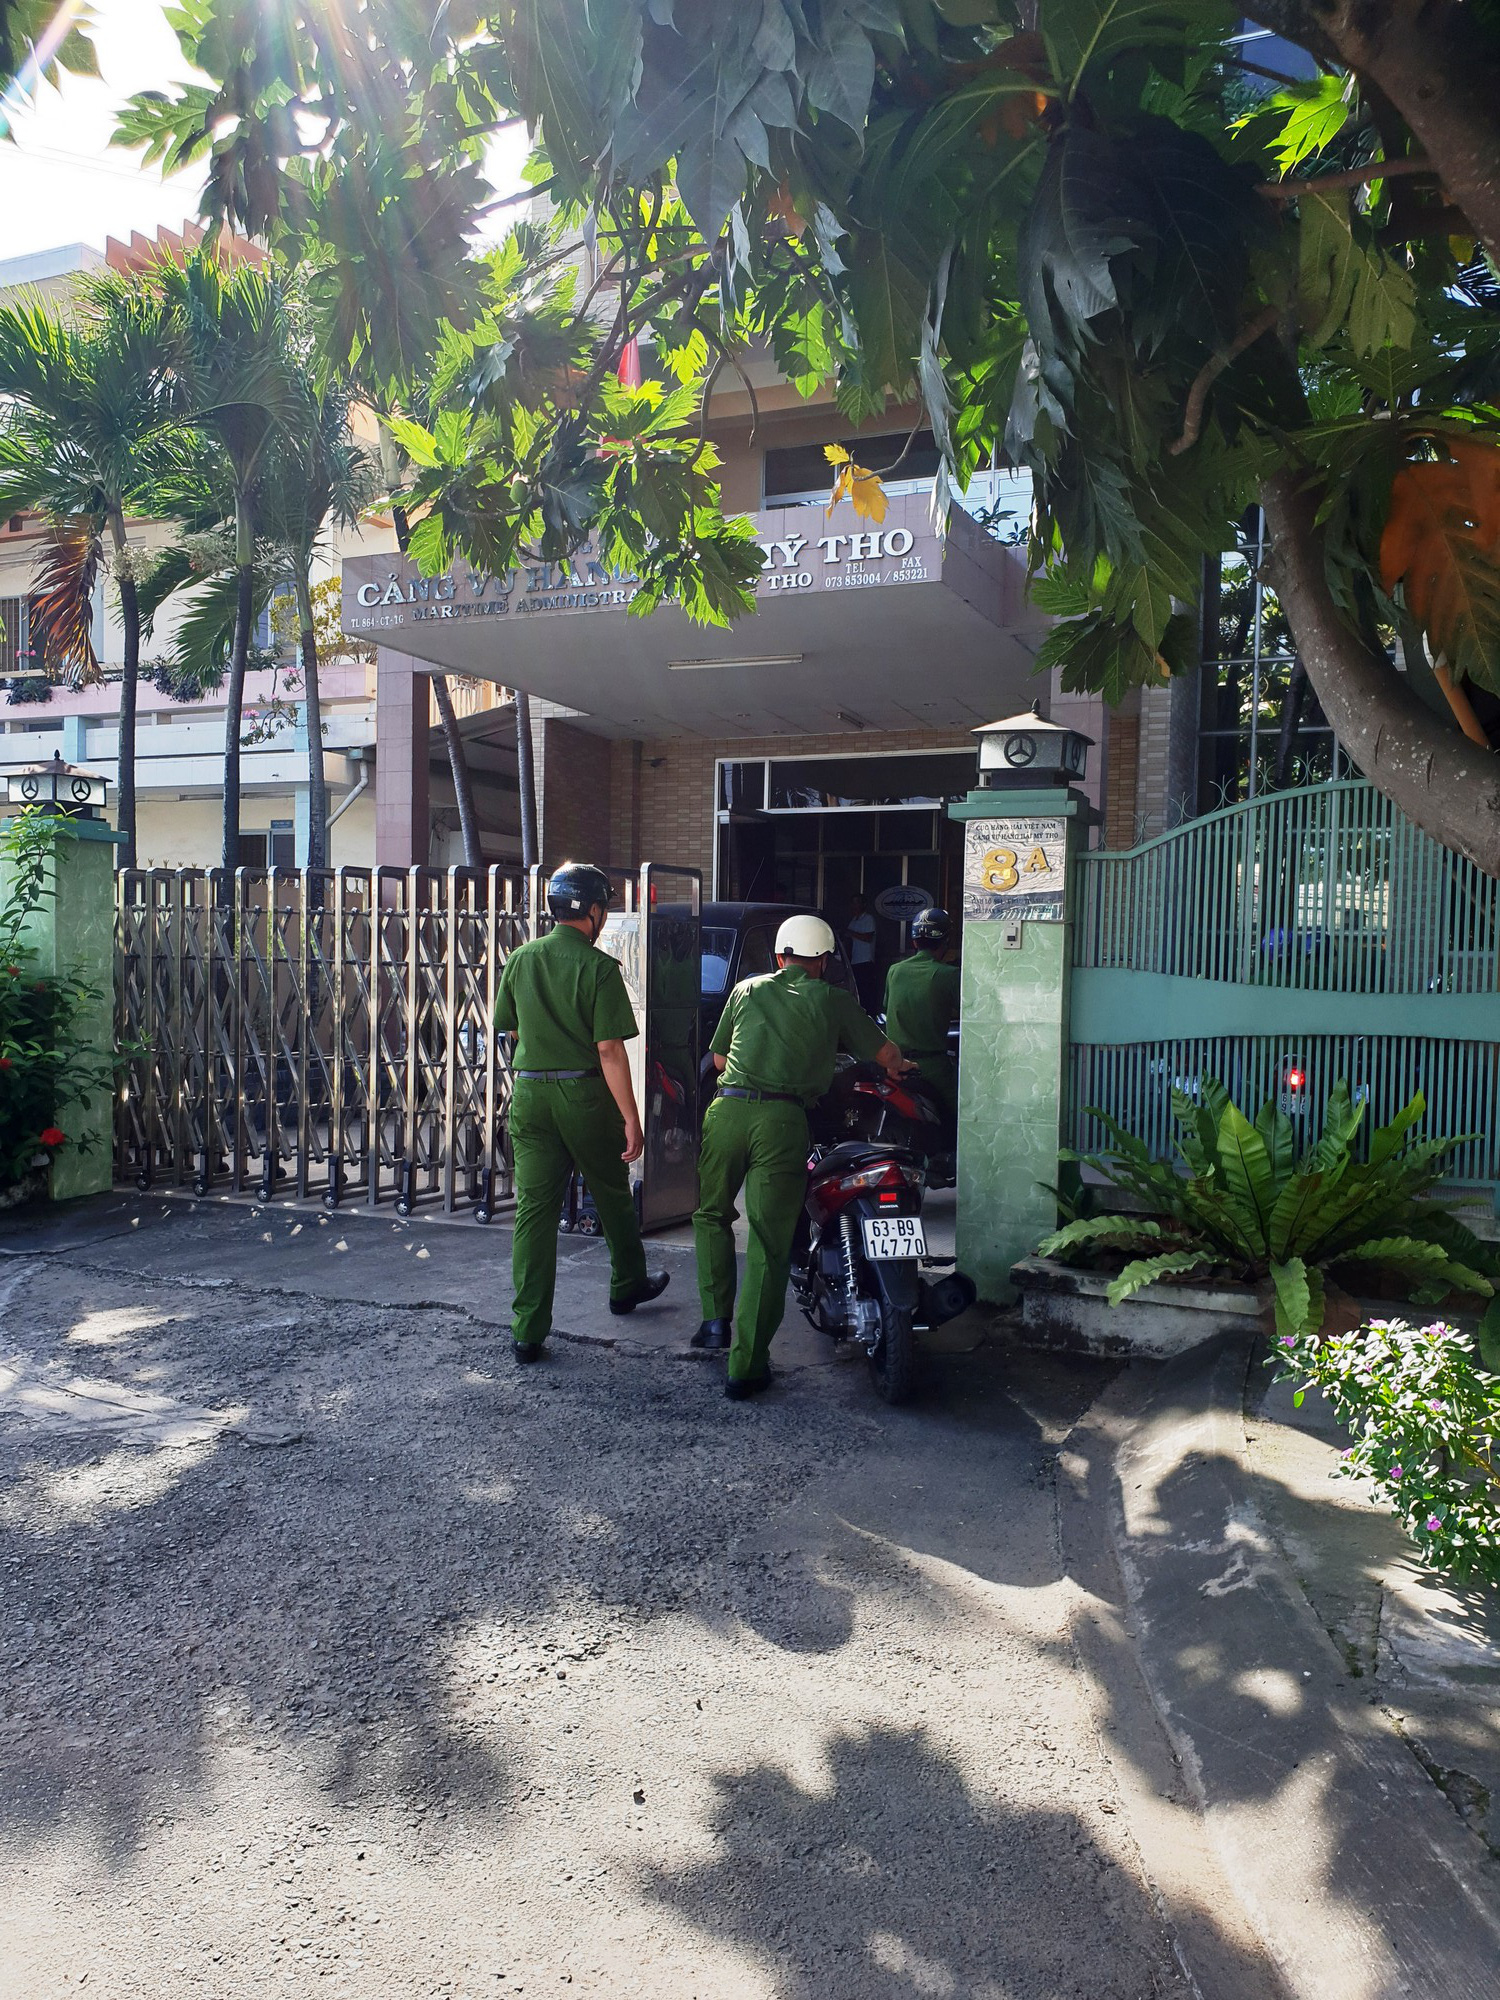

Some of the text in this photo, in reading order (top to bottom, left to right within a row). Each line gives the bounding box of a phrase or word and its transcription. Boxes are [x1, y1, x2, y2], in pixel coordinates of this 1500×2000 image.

[357, 573, 456, 608] CẢNG
[817, 528, 914, 563] THO
[846, 556, 922, 574] TEL FAX
[825, 576, 842, 588] 073
[844, 571, 881, 587] 853004
[893, 569, 928, 583] 853221
[412, 600, 509, 622] MARITIME
[766, 572, 813, 590] THO
[351, 619, 361, 628] TL
[872, 1219, 914, 1237] 63-B9
[870, 1238, 923, 1257] 147.70
